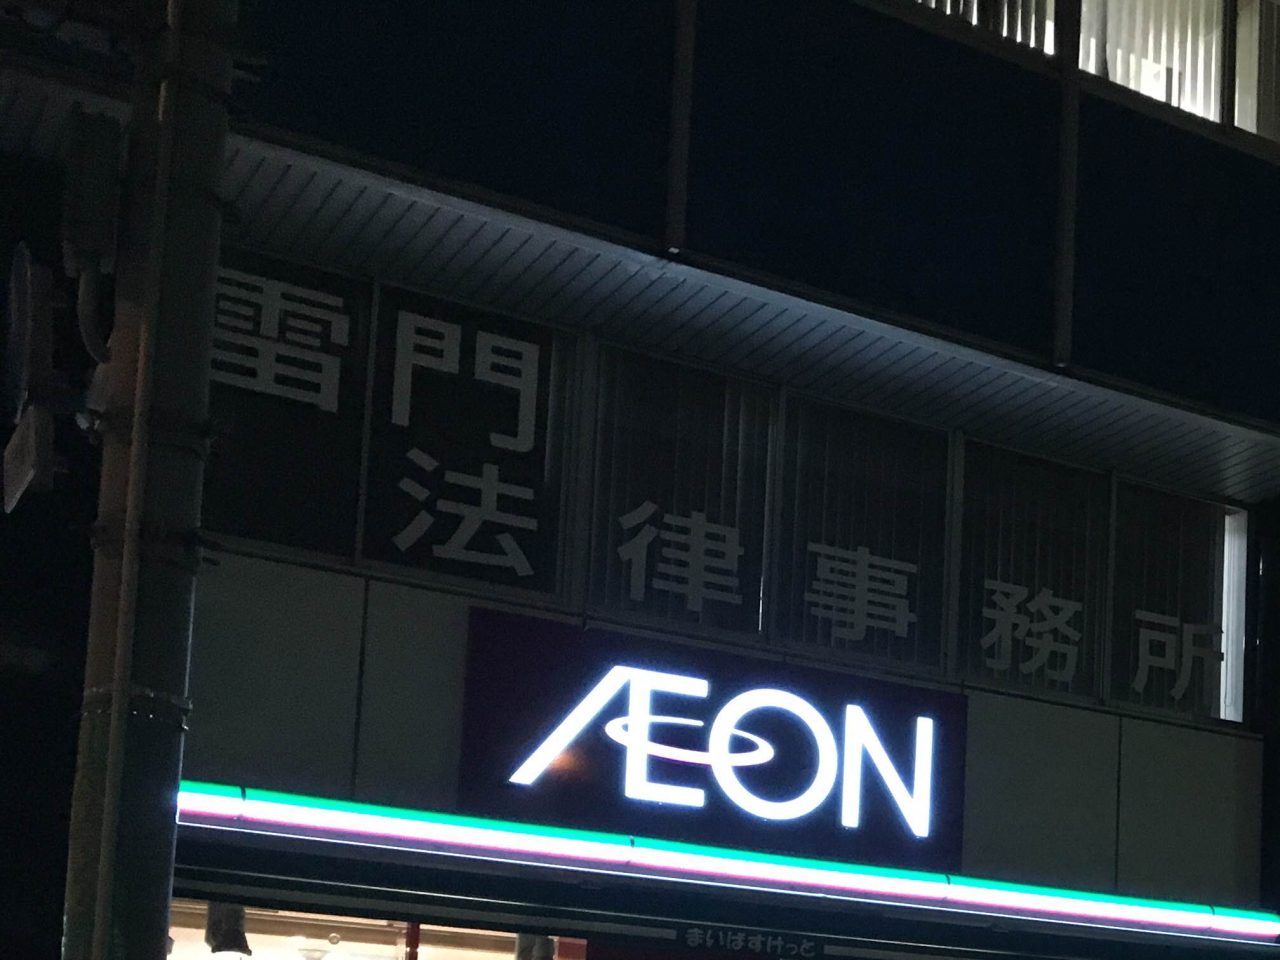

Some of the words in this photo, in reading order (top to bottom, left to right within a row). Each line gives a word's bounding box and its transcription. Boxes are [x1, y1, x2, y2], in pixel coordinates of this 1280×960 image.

[685, 927, 816, 957] まいばすけっと
